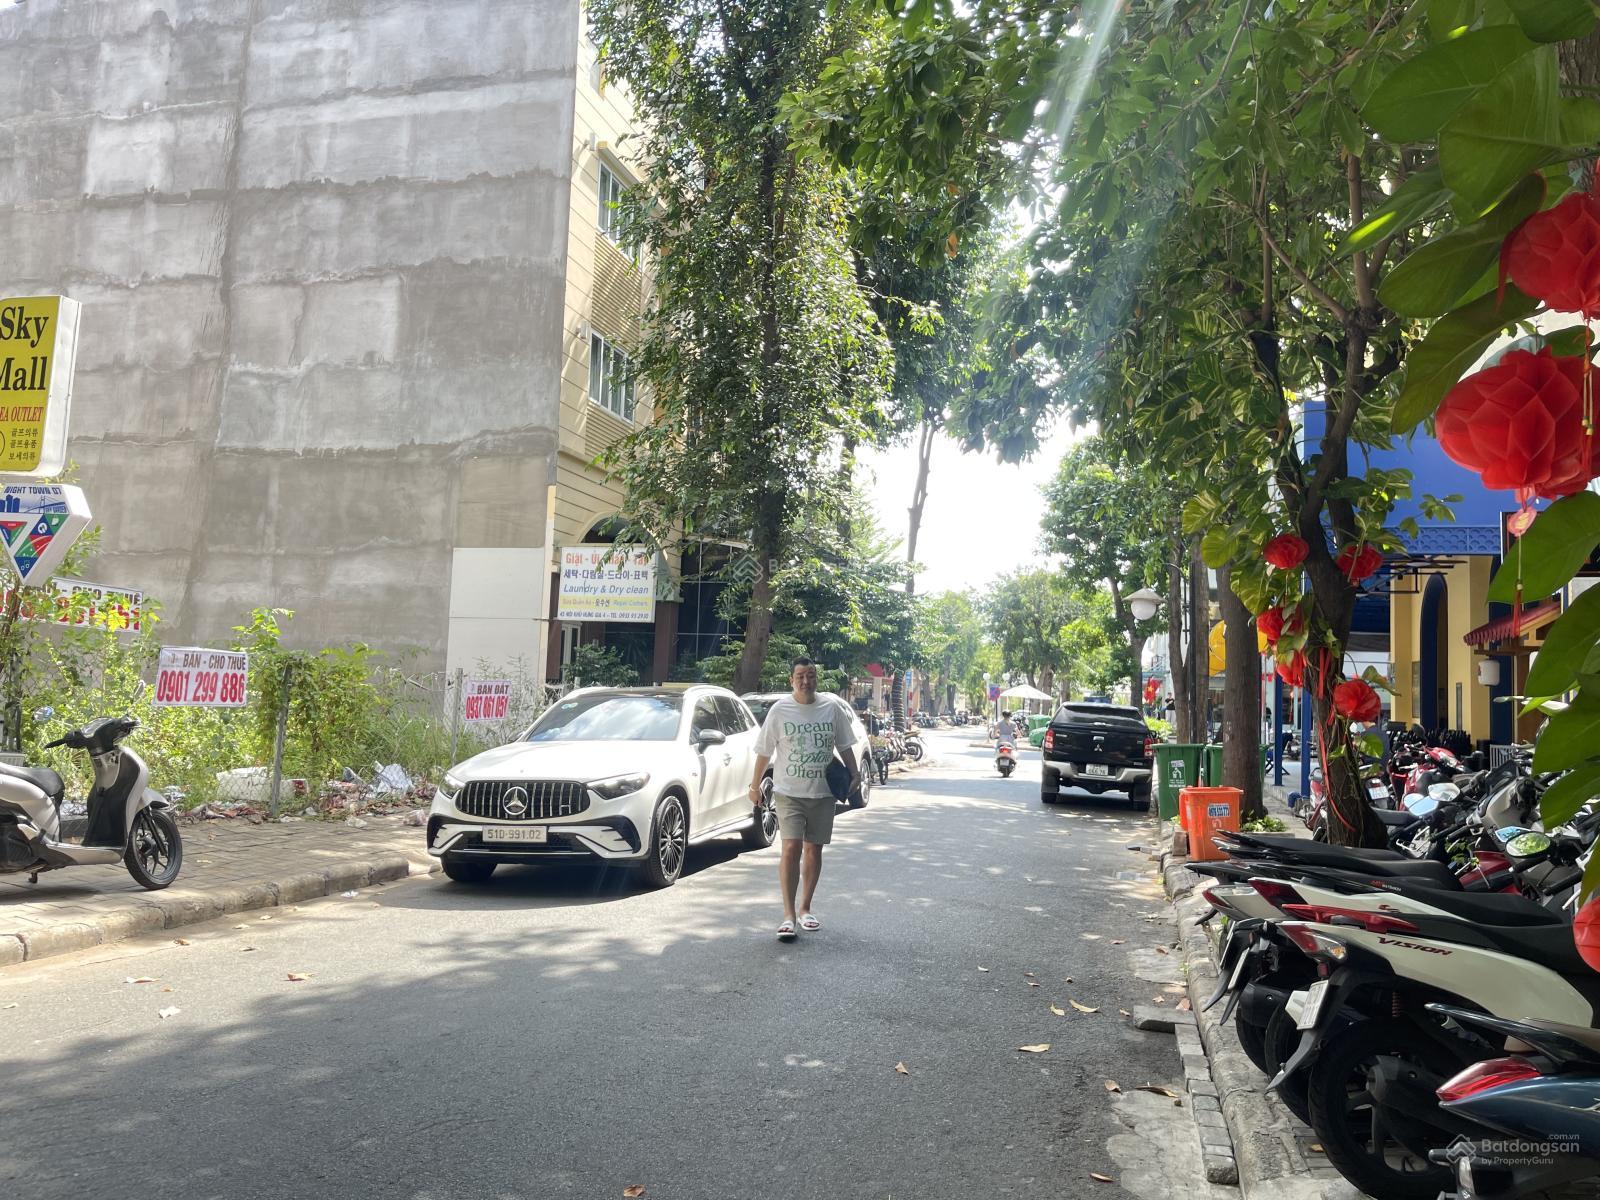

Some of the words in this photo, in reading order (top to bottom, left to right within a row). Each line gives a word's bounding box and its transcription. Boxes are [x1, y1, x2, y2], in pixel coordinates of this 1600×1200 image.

[0, 306, 49, 348] Sky
[11, 406, 44, 421] OUTLET
[564, 584, 599, 595] Laundry
[609, 585, 625, 595] Dry
[626, 586, 649, 594] clean
[209, 654, 225, 669] CHO
[157, 670, 190, 702] 0901
[192, 671, 219, 702] 299
[221, 672, 245, 703] 886
[784, 721, 833, 737] Dream
